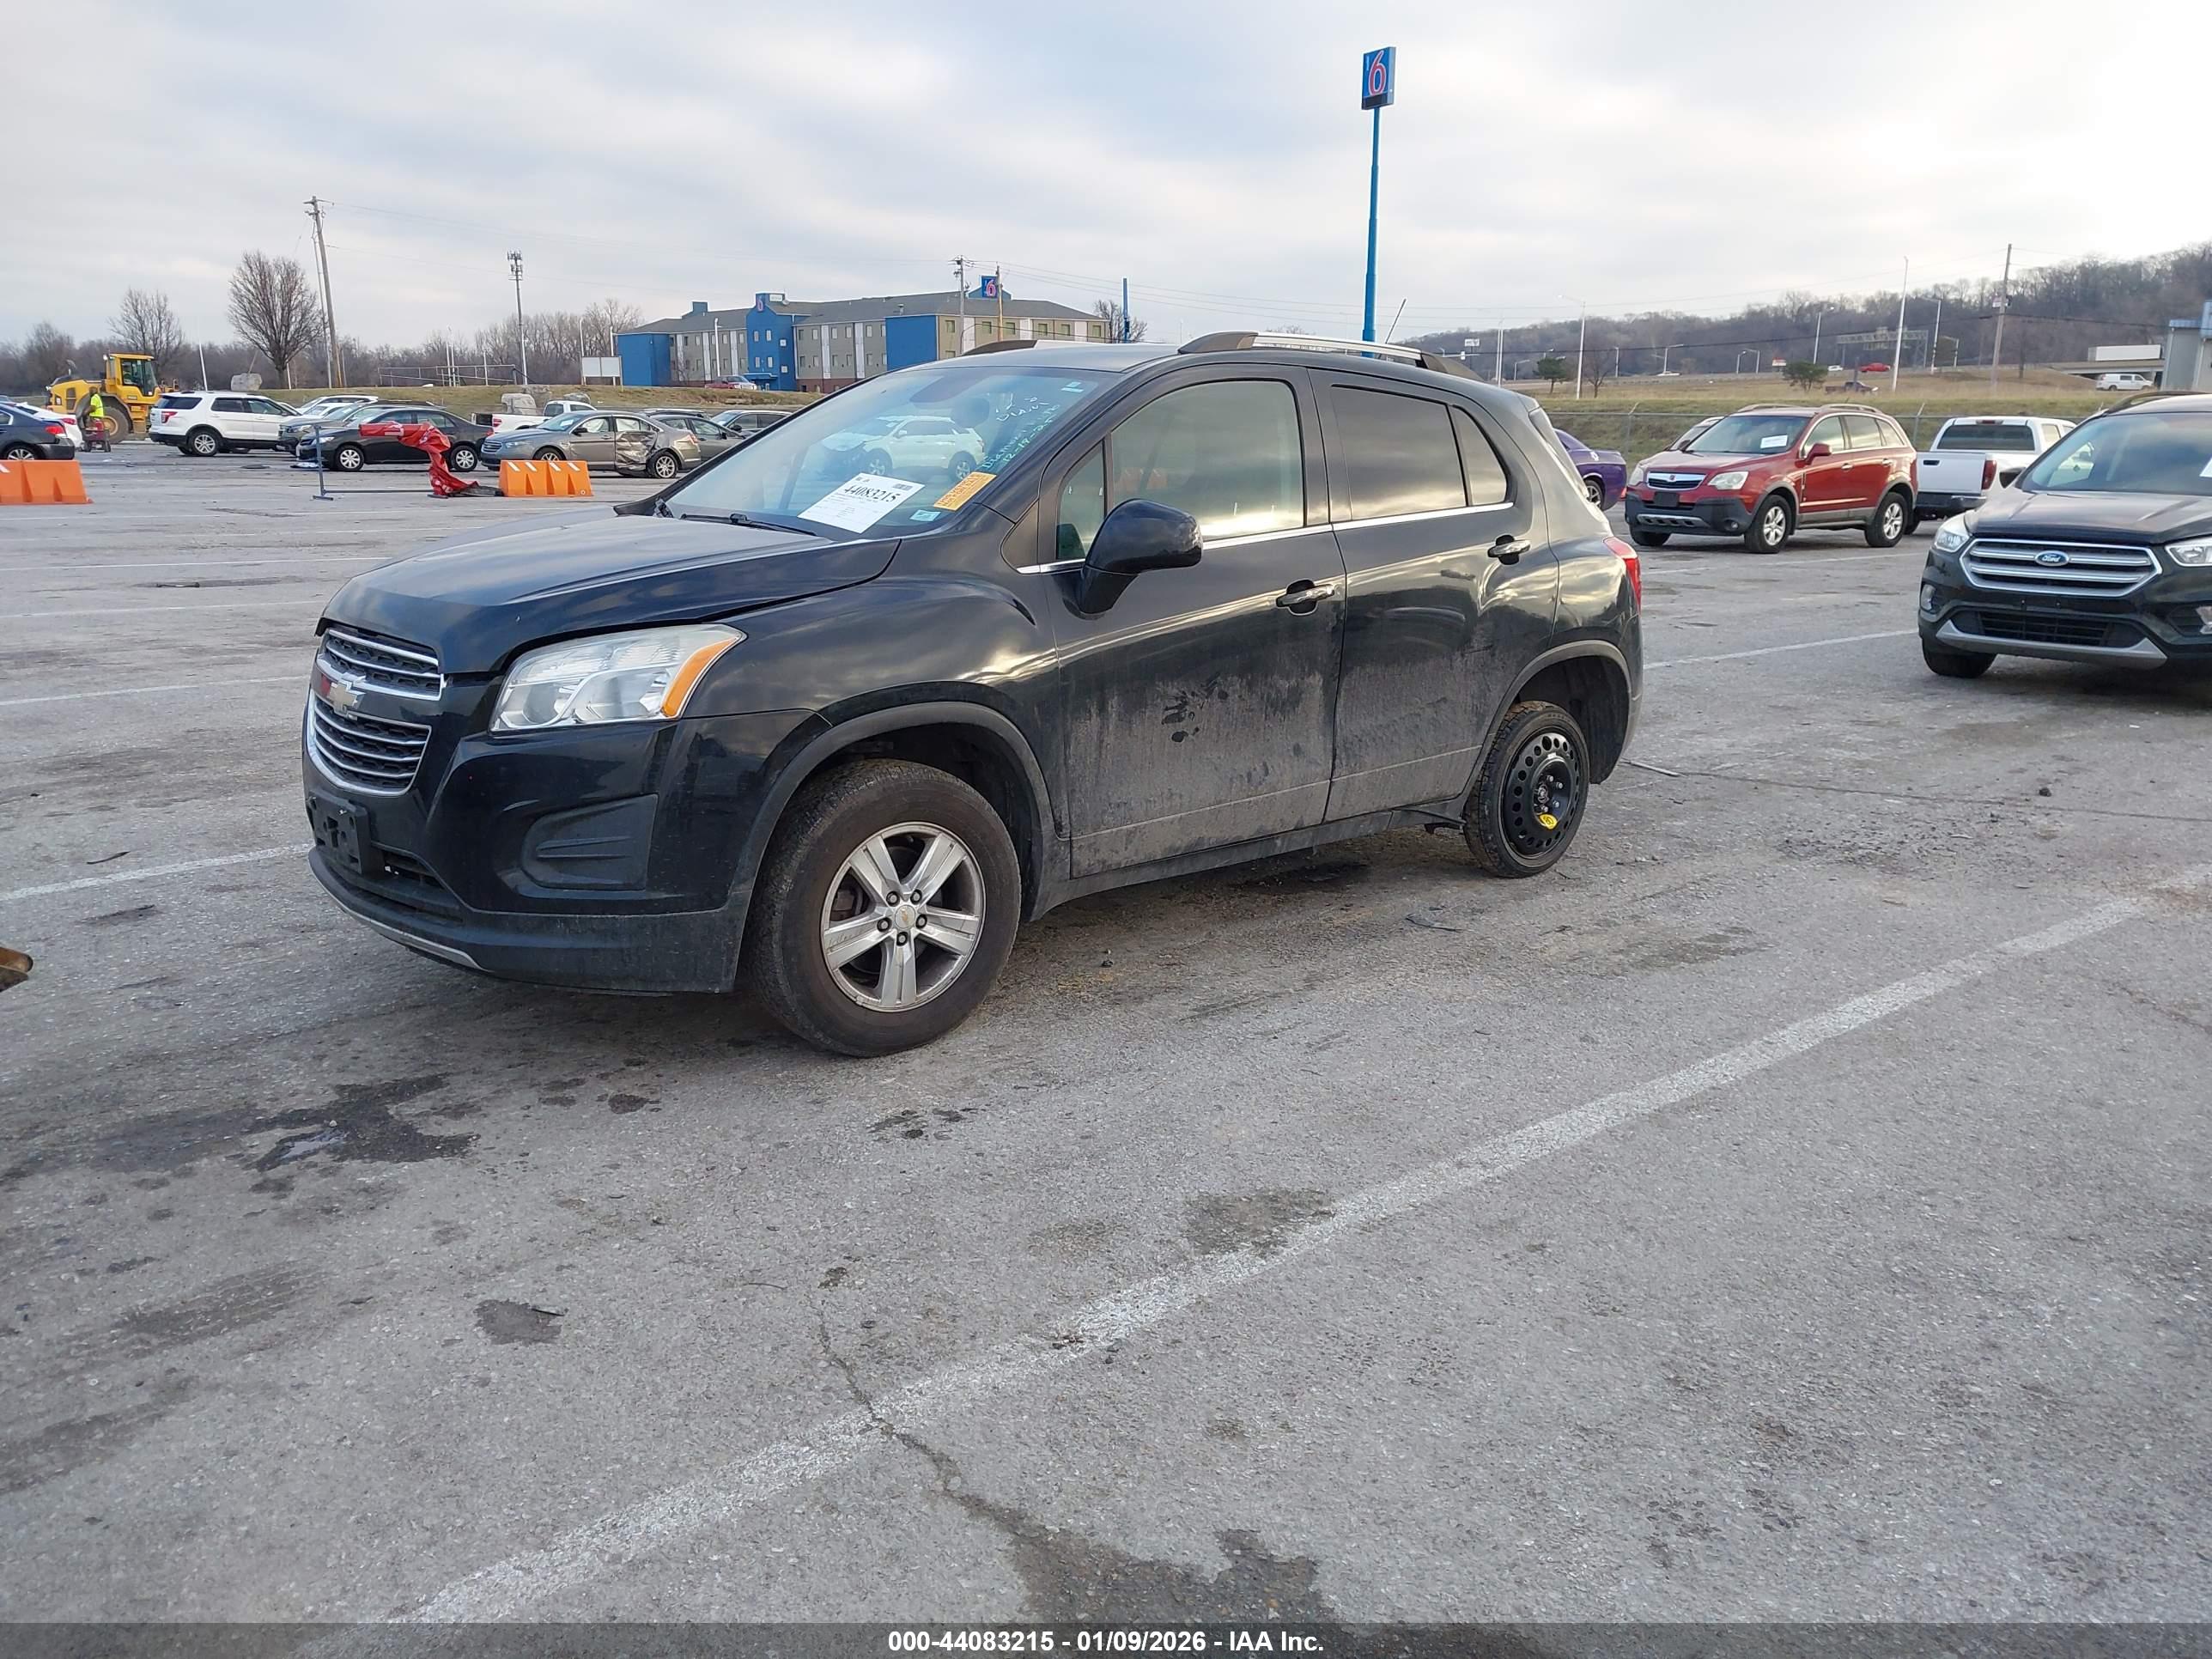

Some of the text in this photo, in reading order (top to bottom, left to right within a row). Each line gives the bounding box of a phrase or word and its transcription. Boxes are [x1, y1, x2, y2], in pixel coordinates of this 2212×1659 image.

[1369, 50, 1386, 96] 6
[986, 279, 996, 297] 6
[844, 484, 901, 502] 44083215
